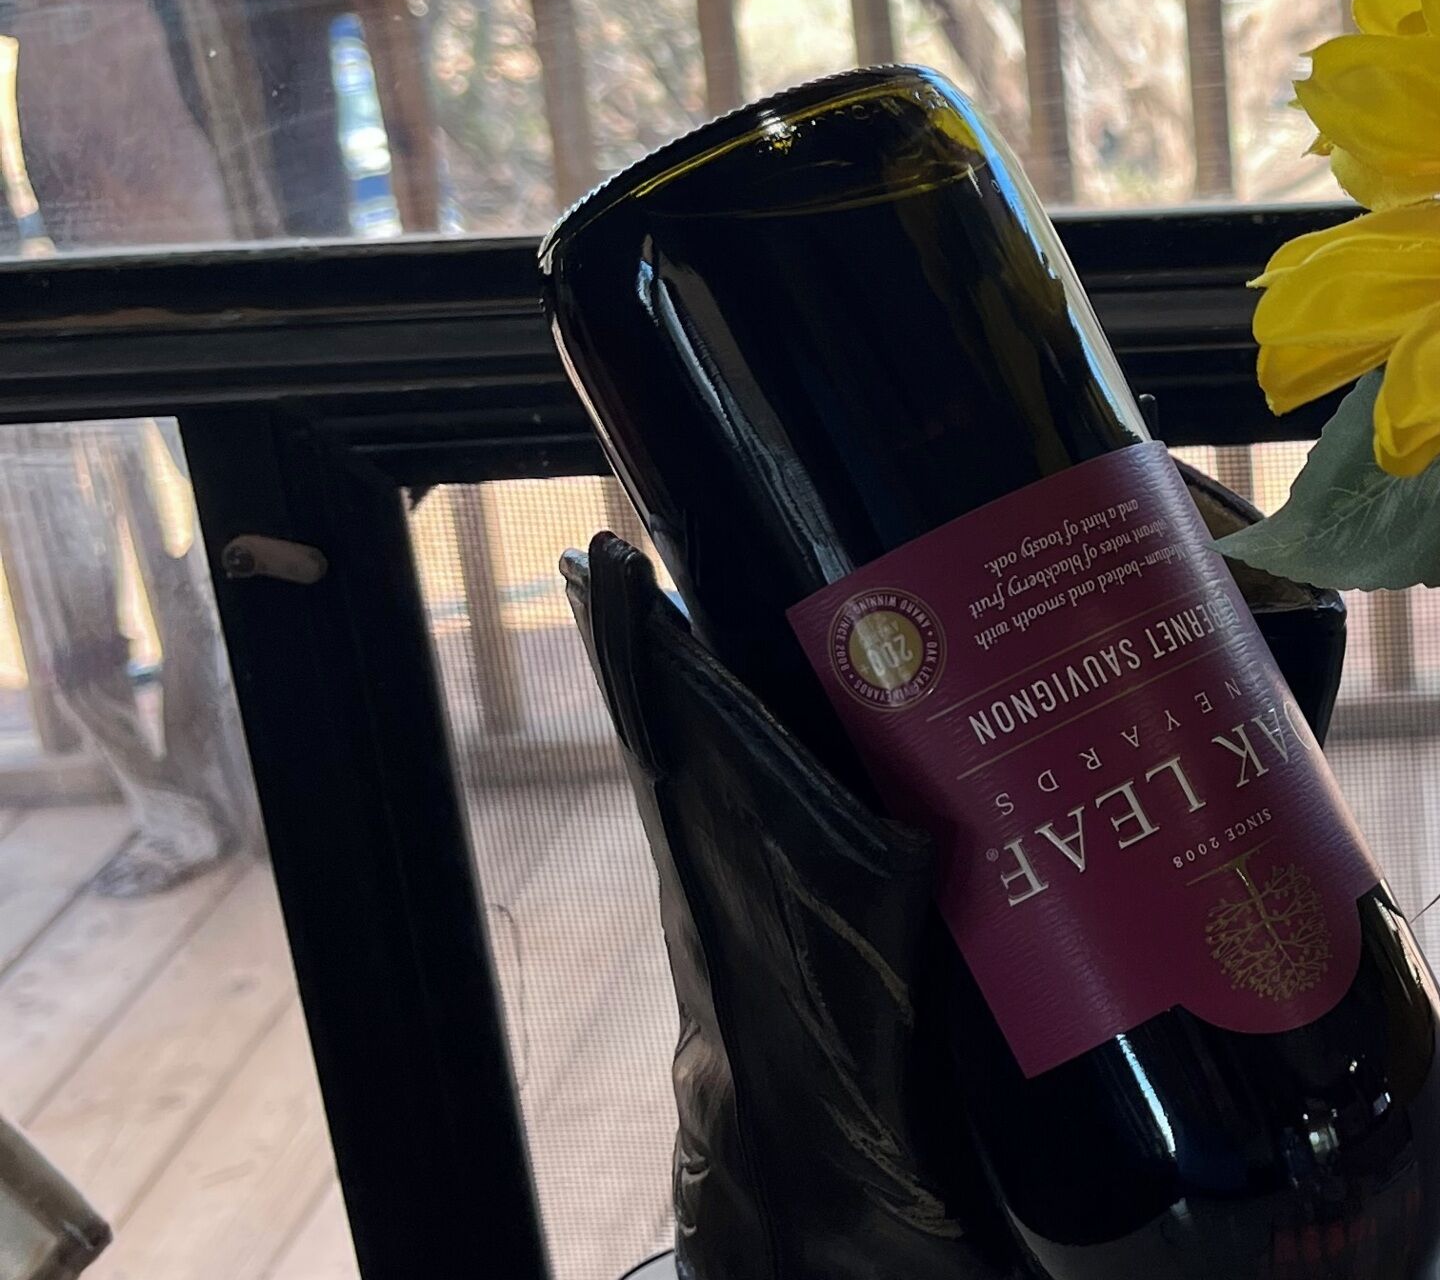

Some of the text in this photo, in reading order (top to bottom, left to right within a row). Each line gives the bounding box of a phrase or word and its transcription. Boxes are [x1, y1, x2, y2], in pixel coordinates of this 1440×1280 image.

[1083, 510, 1109, 533] hint
[1119, 498, 1139, 517] and
[1063, 519, 1079, 546] of
[1101, 534, 1131, 555] notes
[1020, 536, 1064, 560] toasty
[1083, 543, 1098, 569] of
[984, 554, 1017, 577] oak.
[1008, 554, 1084, 597] blackberry
[968, 582, 1005, 619] fruit
[1070, 582, 1095, 608] and
[1012, 595, 1066, 632] smooth
[974, 618, 1011, 650] with
[968, 638, 1141, 745] SAUVIGNON
[995, 665, 1280, 816] NEYARDS
[1212, 701, 1314, 787] OAK
[1173, 807, 1272, 869] SINCE 2008
